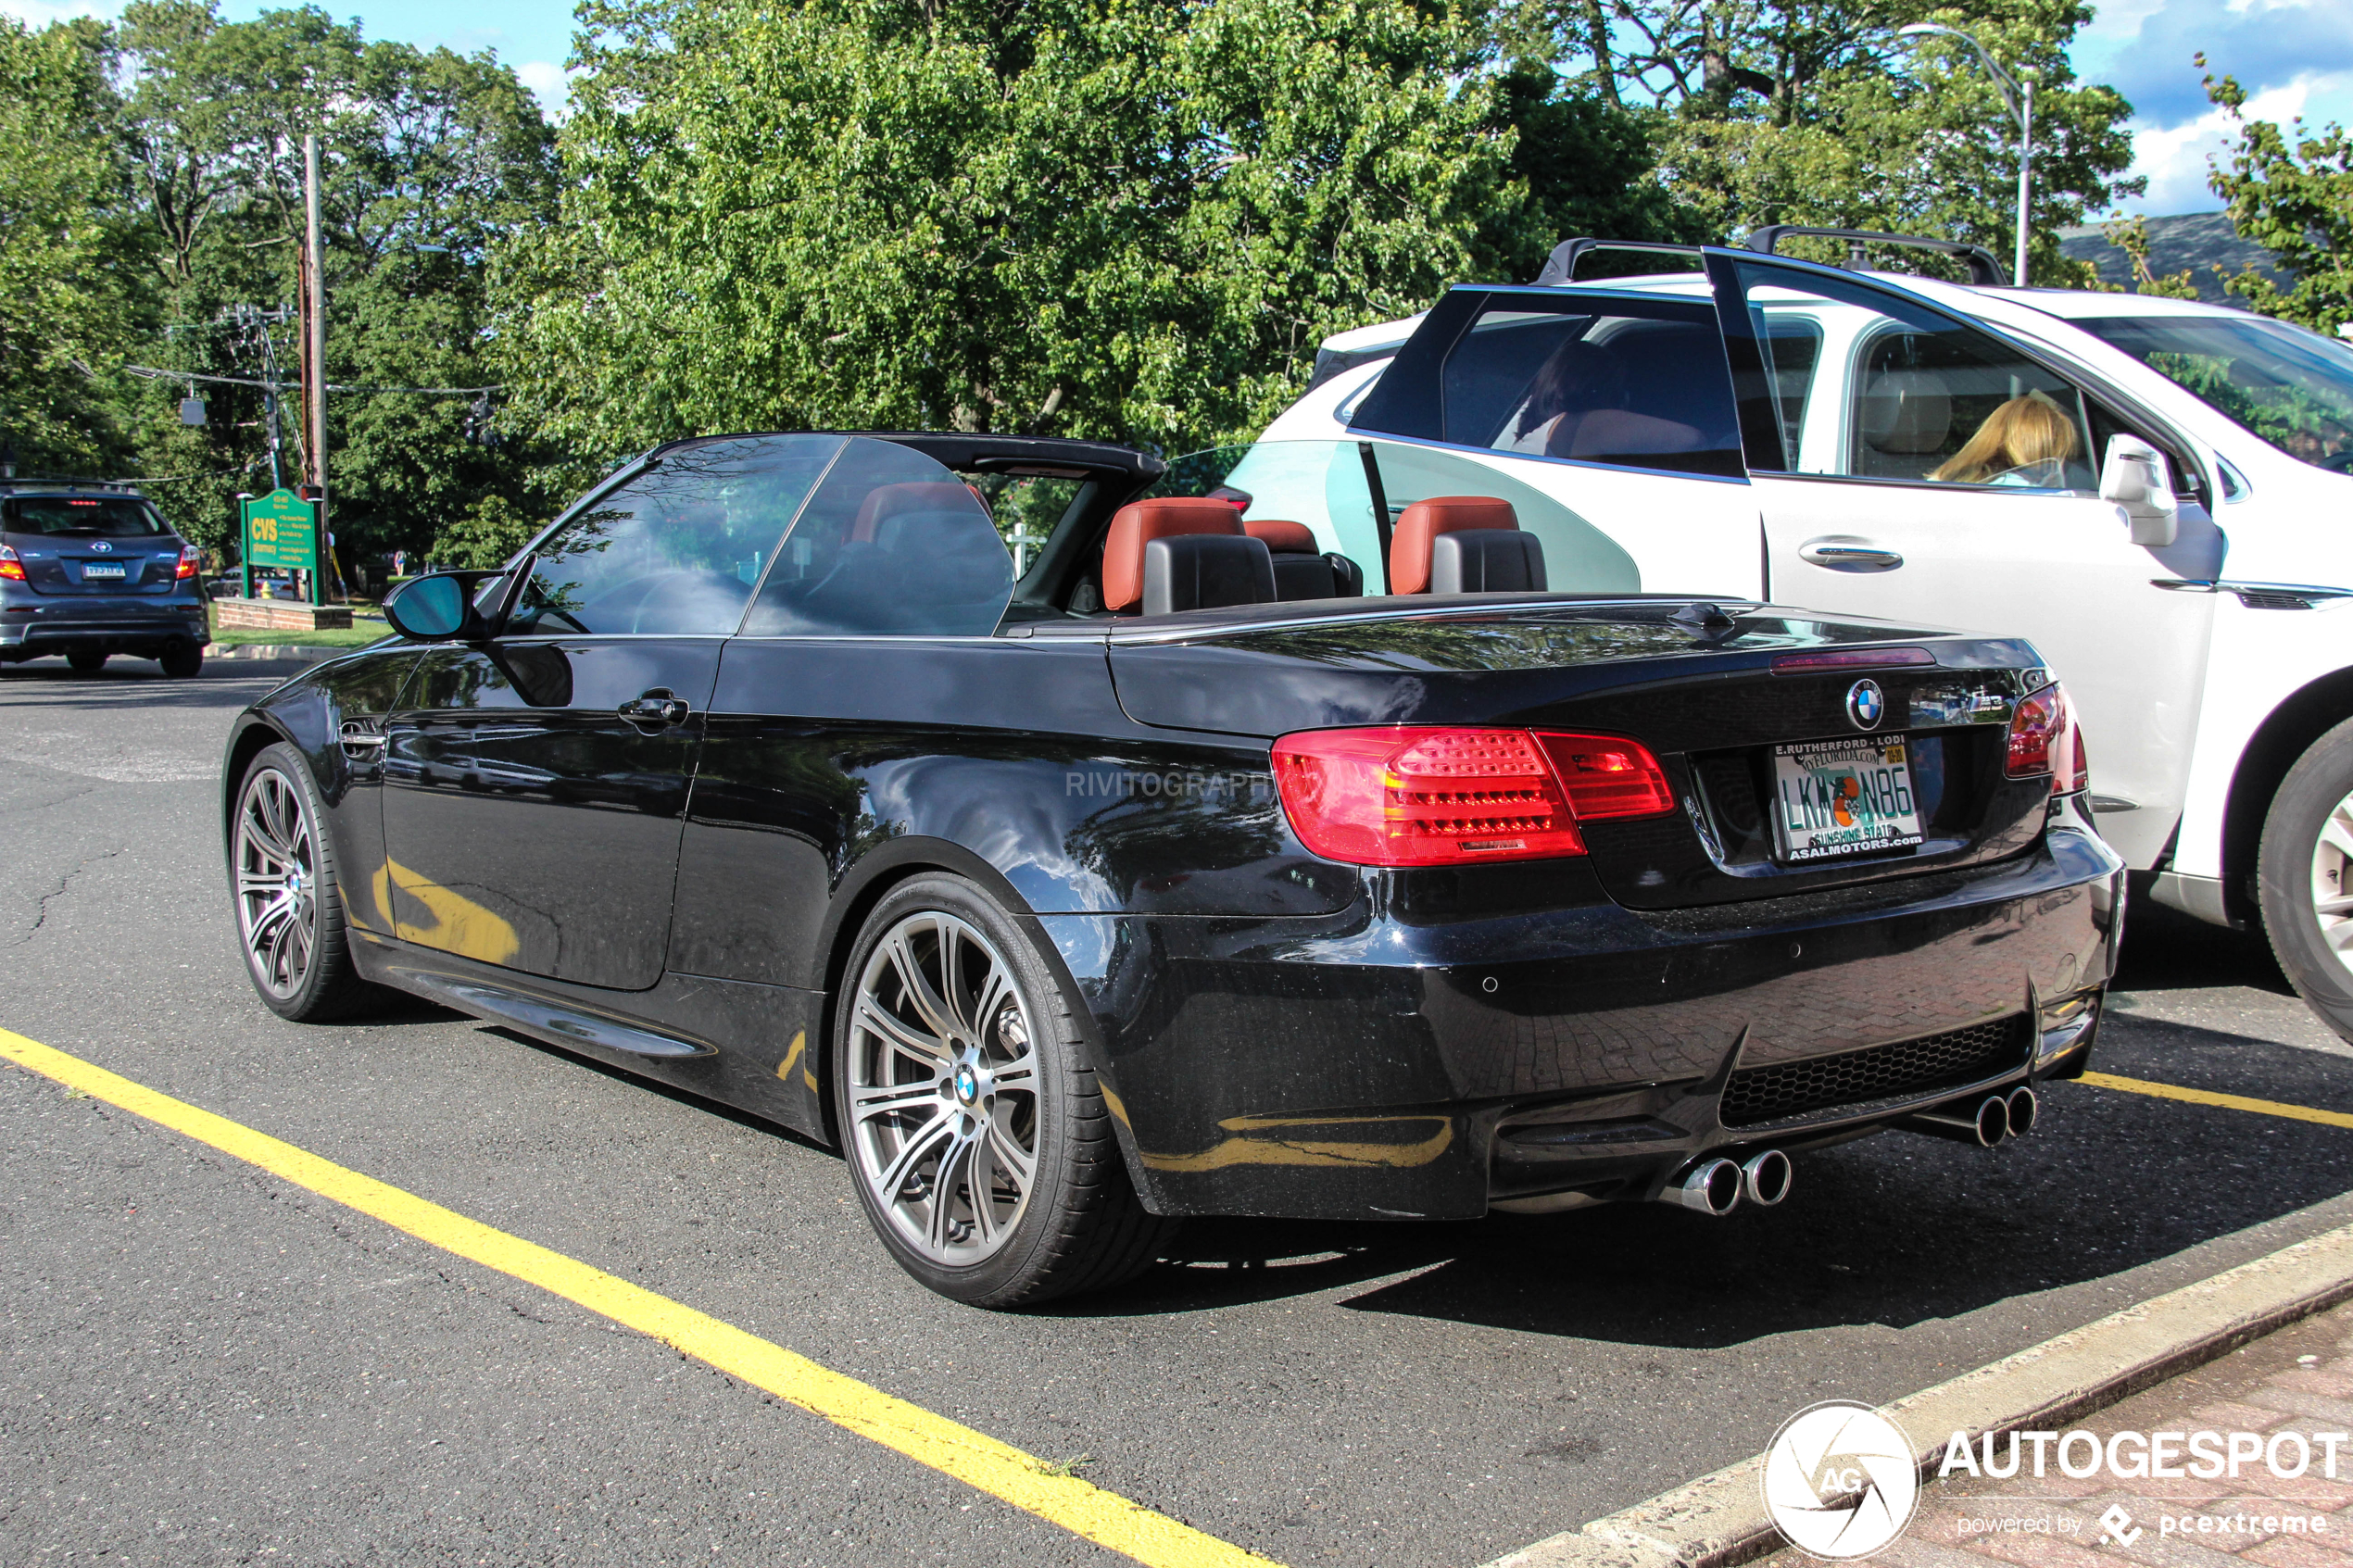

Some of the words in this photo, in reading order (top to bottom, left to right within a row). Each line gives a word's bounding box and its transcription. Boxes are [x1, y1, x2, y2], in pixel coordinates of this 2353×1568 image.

[251, 518, 278, 542] CVS
[1775, 739, 1868, 755] E.RUTHERFORD
[1877, 734, 1906, 746] LODI
[1781, 775, 1837, 832] LKM
[1860, 766, 1912, 822] N86
[1789, 834, 1923, 861] ASALMOTORS.com
[1813, 825, 1861, 847] SUNSHINE
